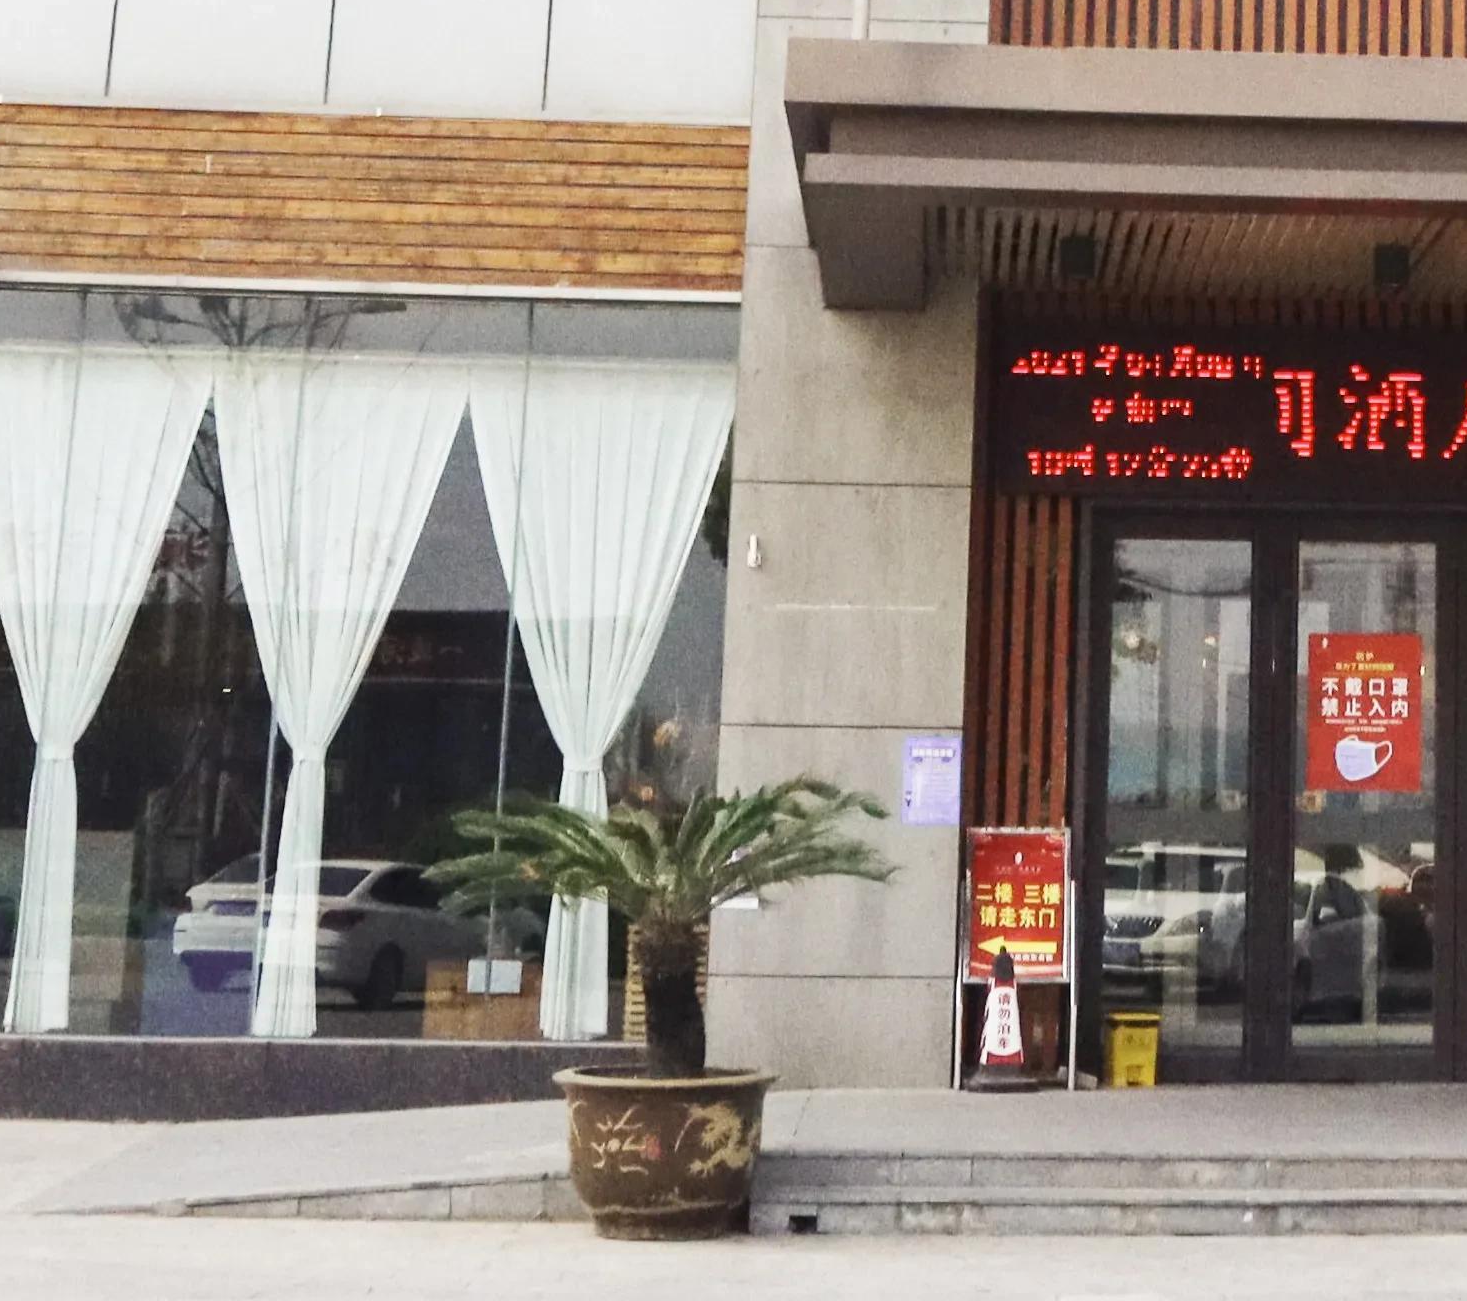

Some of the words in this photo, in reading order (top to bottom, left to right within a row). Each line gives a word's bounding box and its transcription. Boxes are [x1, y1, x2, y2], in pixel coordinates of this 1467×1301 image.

[1321, 677, 1409, 696] 不戴口罩
[1321, 697, 1409, 717] 禁止入内
[976, 882, 1013, 904] 二楼
[1024, 883, 1061, 905] 三楼
[980, 905, 1055, 928] 请走东门
